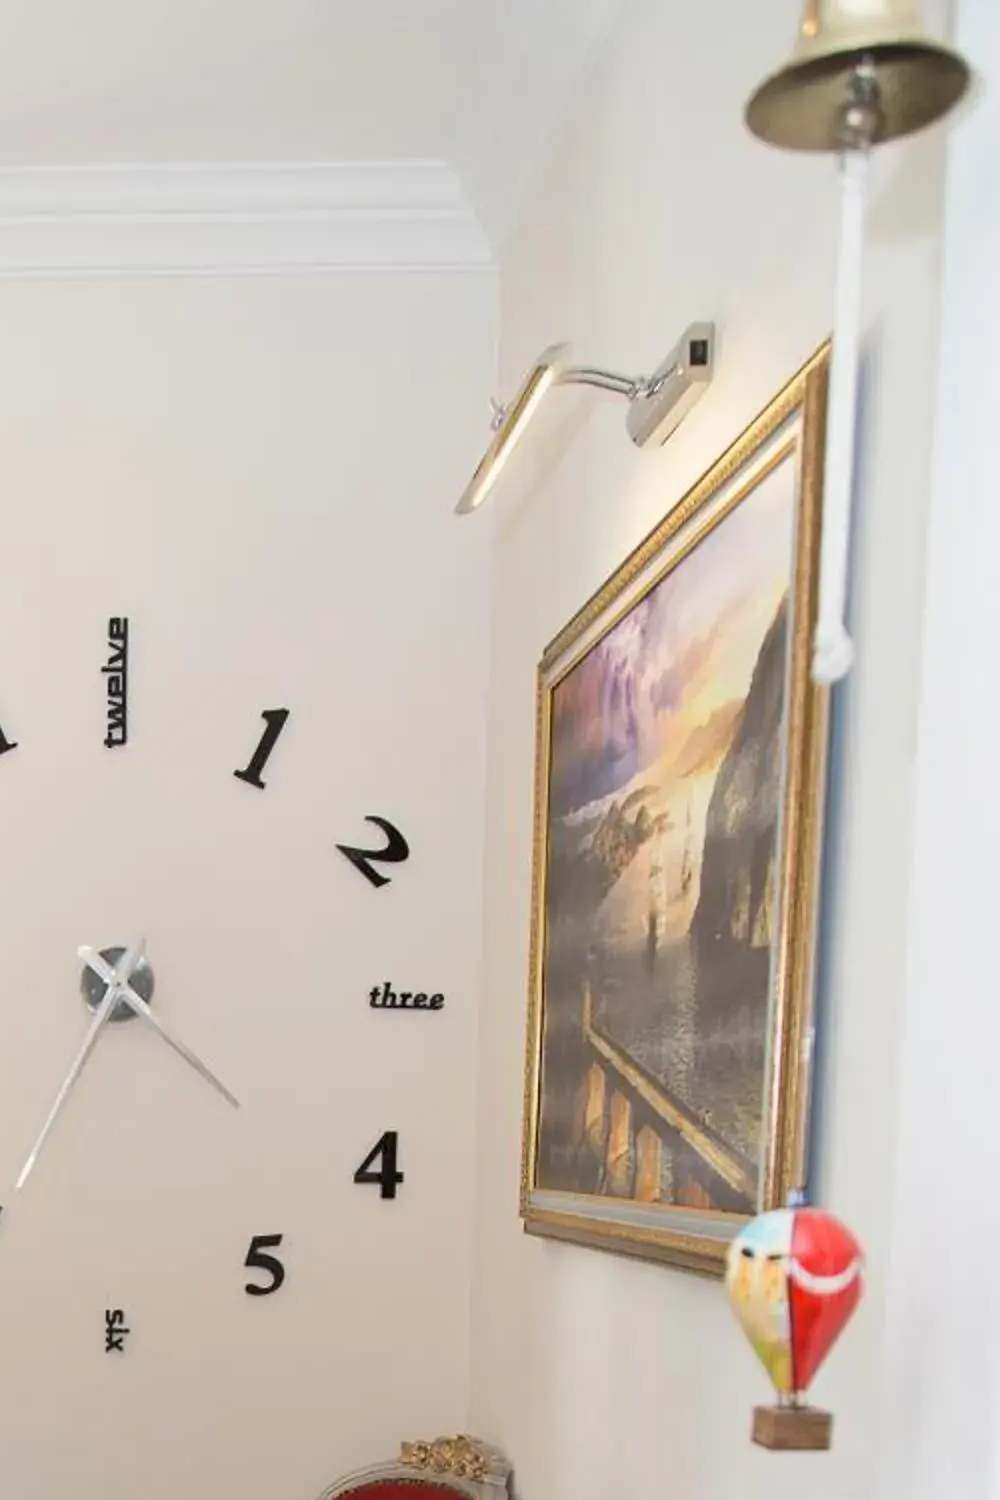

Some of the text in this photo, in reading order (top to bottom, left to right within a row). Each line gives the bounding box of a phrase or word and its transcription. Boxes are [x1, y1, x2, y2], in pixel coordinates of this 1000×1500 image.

[101, 617, 129, 749] twelve
[234, 707, 290, 790] 1
[335, 815, 411, 888] 2
[369, 981, 446, 1011] three
[353, 1130, 405, 1200] 4
[243, 1233, 286, 1296] 5
[105, 1308, 131, 1353] six
